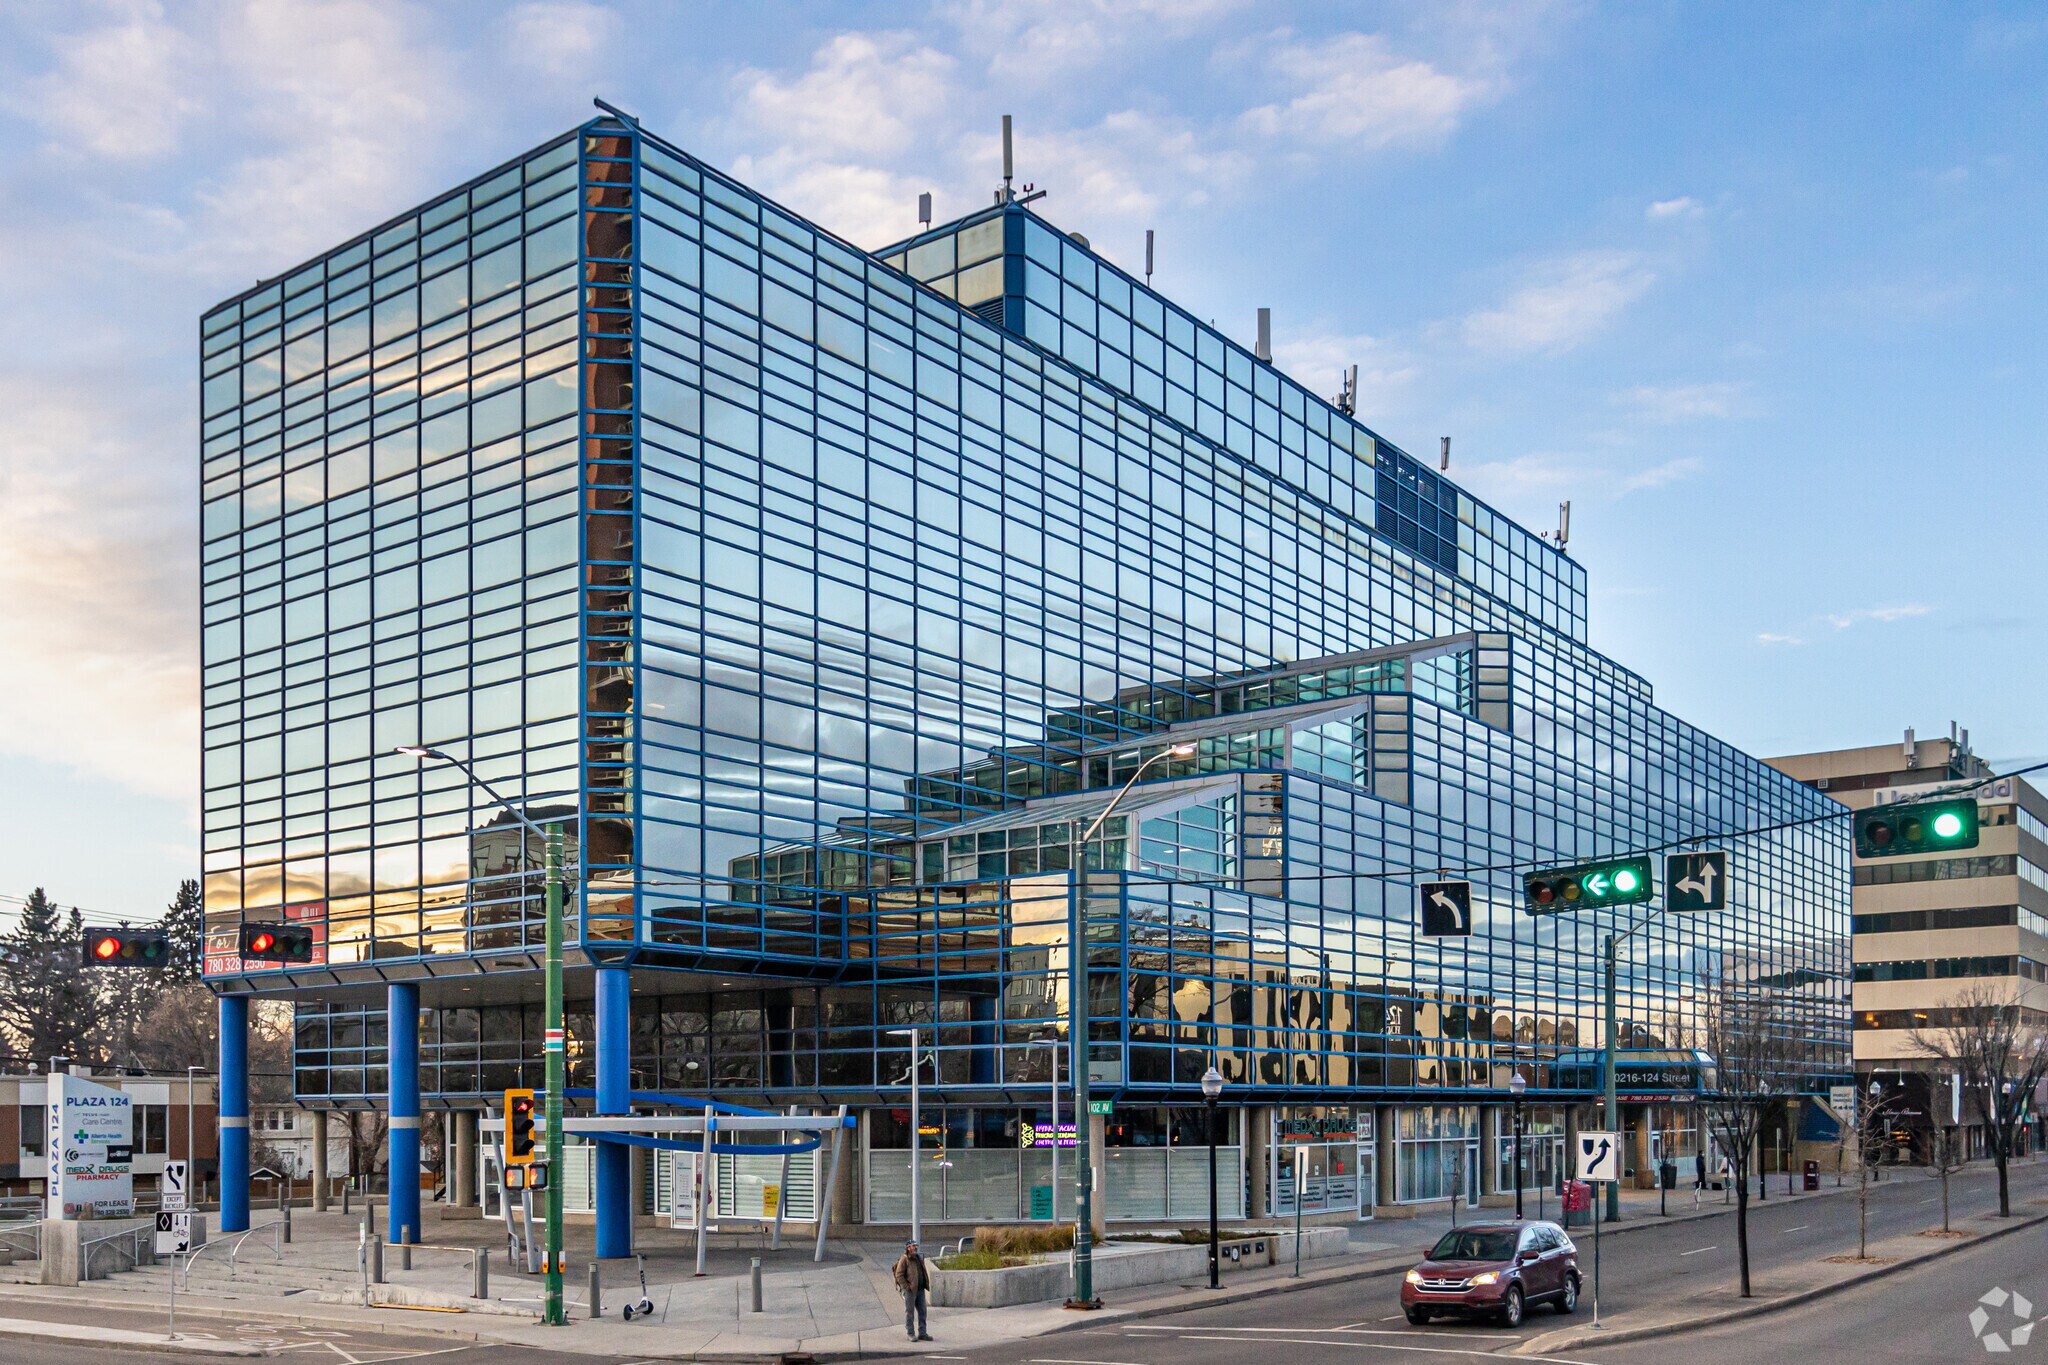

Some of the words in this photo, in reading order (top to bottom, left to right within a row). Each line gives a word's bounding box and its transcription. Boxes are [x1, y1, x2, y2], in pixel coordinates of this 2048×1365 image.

[208, 958, 223, 973] 780
[225, 957, 241, 972] 328
[1661, 1073, 1691, 1083] Street
[66, 1097, 107, 1107] PLAZA
[110, 1097, 129, 1107] 124
[1090, 1103, 1100, 1113] 102
[1101, 1103, 1110, 1112] AV
[82, 1118, 99, 1126] Care
[98, 1165, 129, 1173] DRUGS
